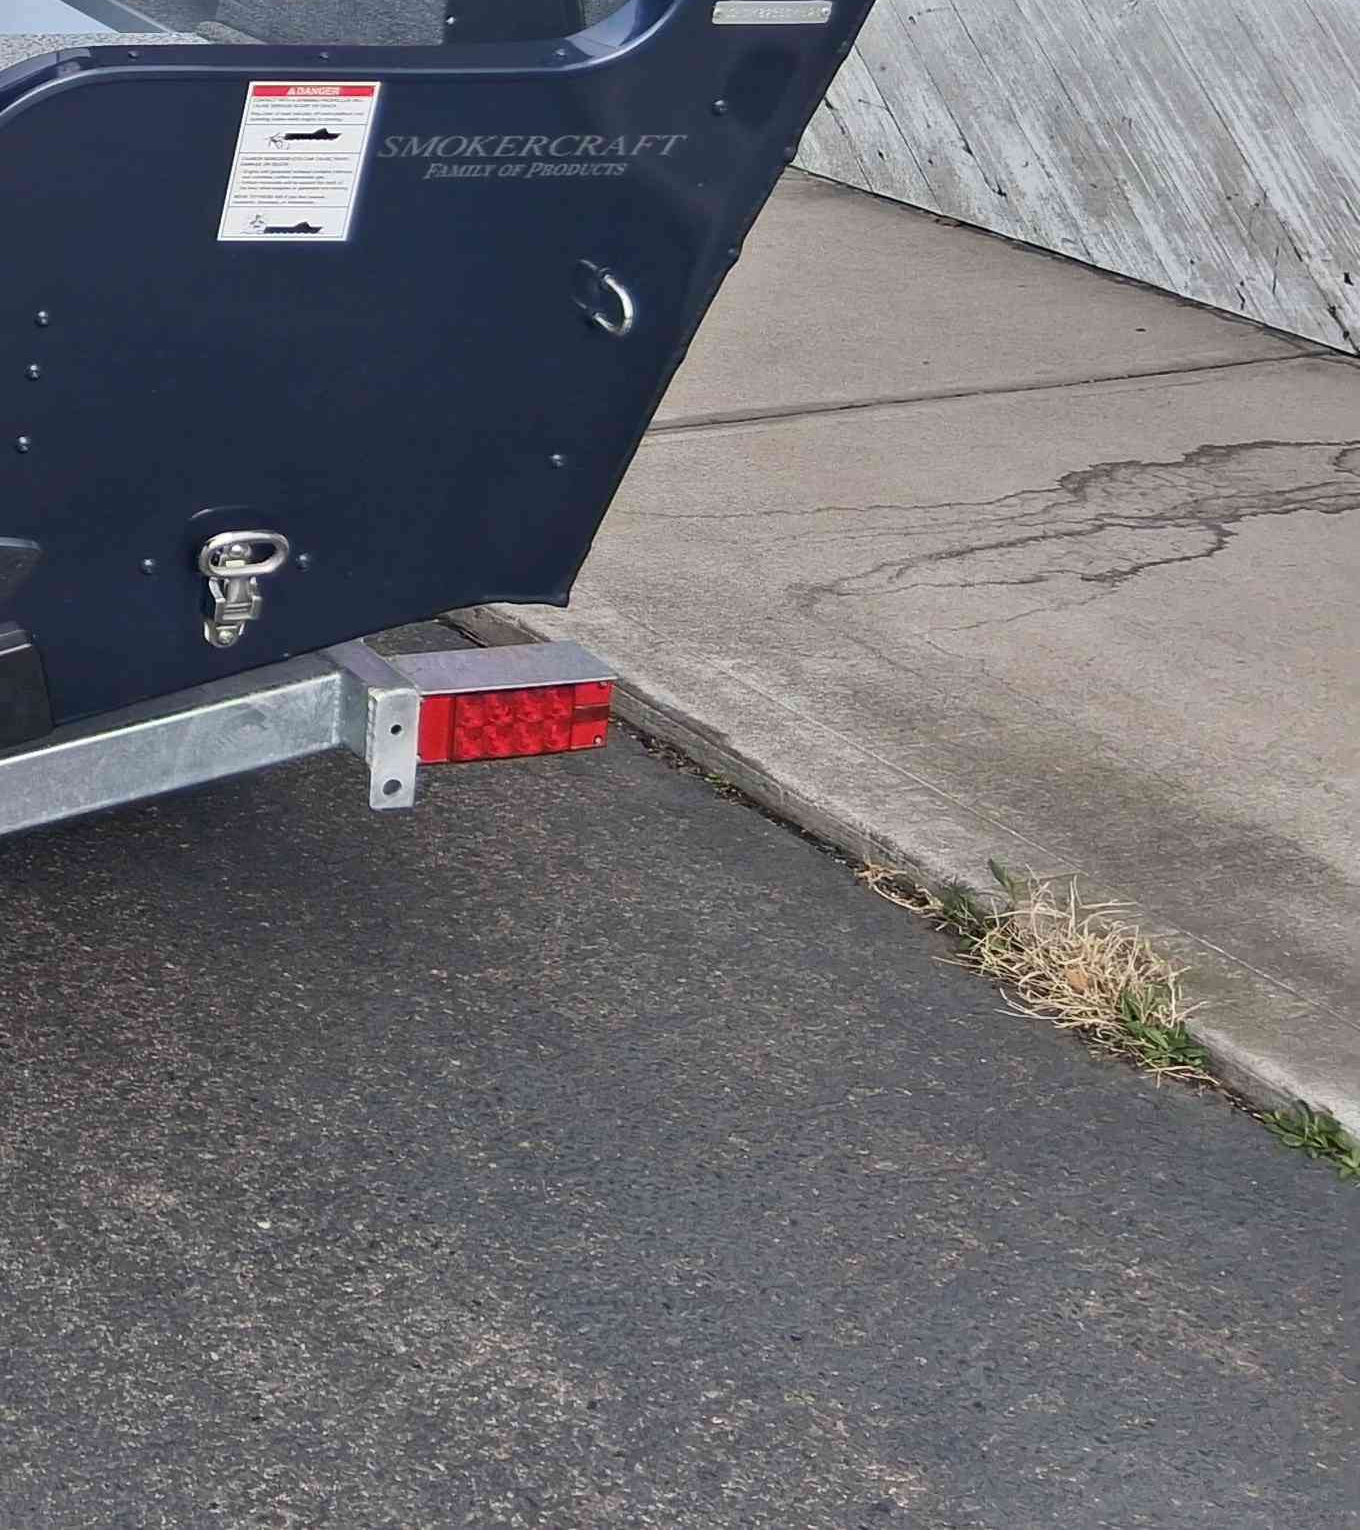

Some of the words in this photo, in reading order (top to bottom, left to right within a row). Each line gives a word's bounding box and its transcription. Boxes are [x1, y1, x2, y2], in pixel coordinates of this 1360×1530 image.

[295, 86, 341, 96] DANGER
[377, 134, 688, 158] SMOKERCRAFT
[423, 162, 495, 180] FAMILY
[498, 163, 525, 177] OF
[526, 162, 628, 179] PRODUCTS
